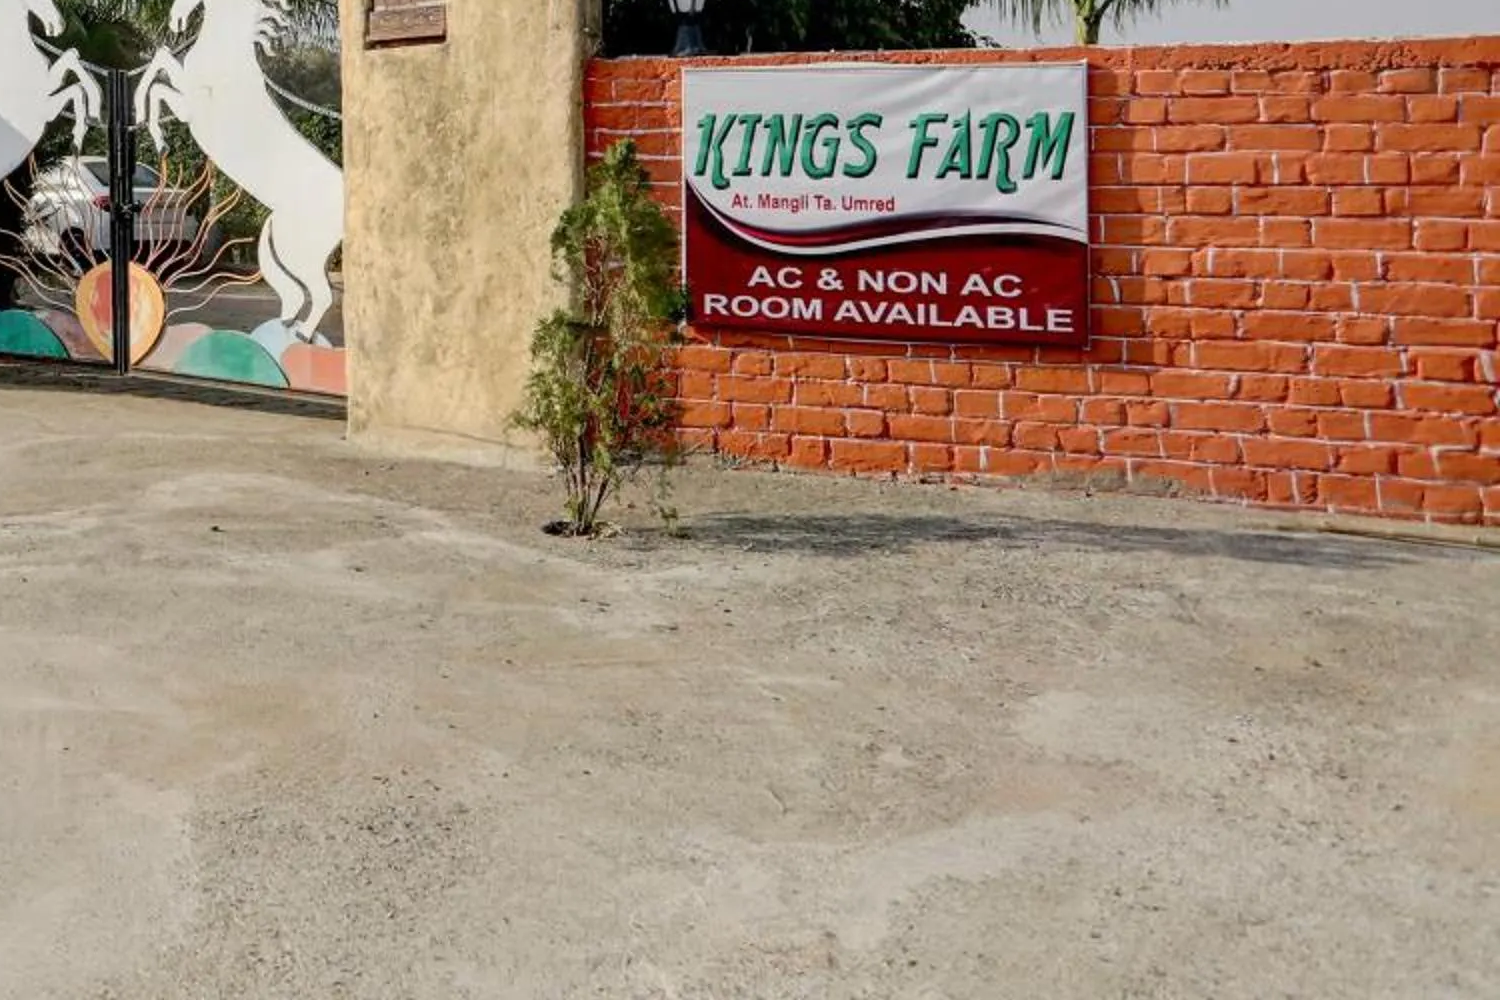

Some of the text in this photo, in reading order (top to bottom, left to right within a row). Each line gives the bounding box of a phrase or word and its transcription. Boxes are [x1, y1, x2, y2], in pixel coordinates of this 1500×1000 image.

[694, 107, 1076, 194] KINGS FARM
[731, 193, 753, 209] At.
[813, 194, 838, 212] Ta.
[841, 195, 895, 212] Umred
[747, 265, 1023, 298] AC & NON AC
[703, 293, 1075, 333] ROOM AVAILABLE
